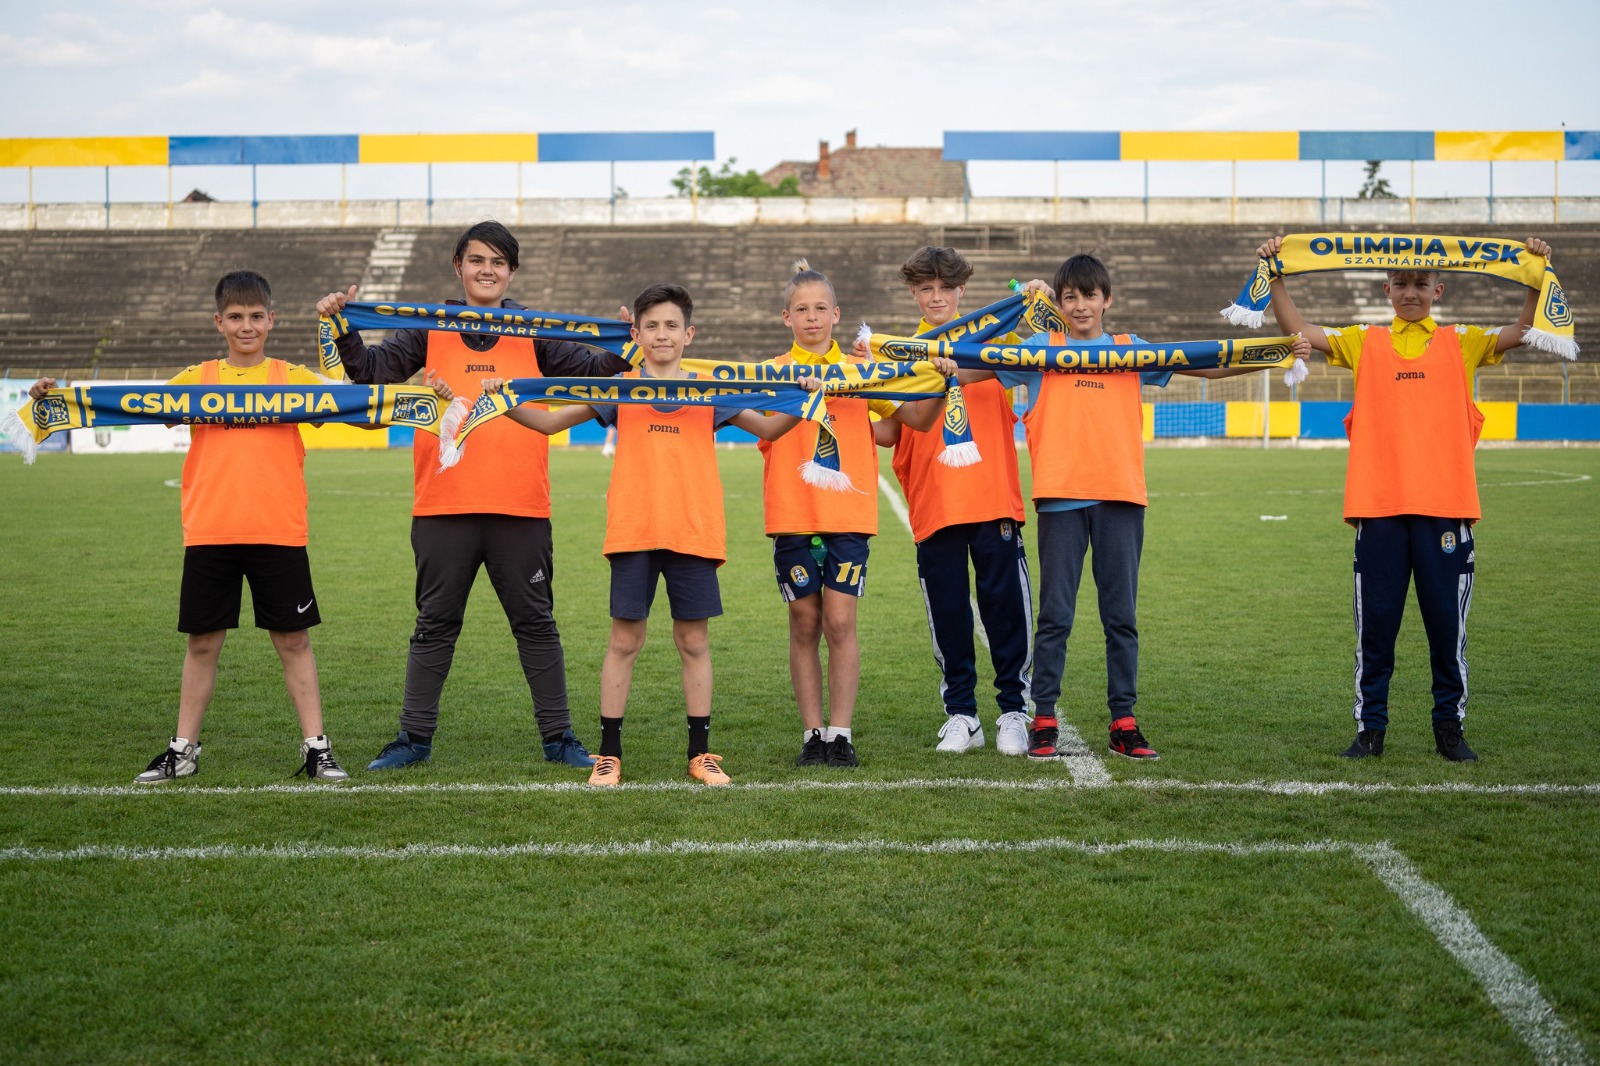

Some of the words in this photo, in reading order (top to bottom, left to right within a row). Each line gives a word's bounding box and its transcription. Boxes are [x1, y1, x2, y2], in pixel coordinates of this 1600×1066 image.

[1309, 237, 1447, 257] OLIMPIA
[1457, 240, 1525, 265] VSK
[1344, 256, 1487, 269] SZATMÁRNÉMETI
[437, 320, 481, 330] SATU
[489, 324, 538, 336] MARE
[980, 346, 1046, 367] CSM
[1055, 349, 1190, 368] OLIMPIA
[712, 364, 847, 381] OLIMPIA
[855, 361, 917, 380] VSK
[120, 392, 190, 414] CSM
[200, 392, 339, 414] OLIMPIA
[182, 416, 225, 424] SATU
[233, 416, 280, 424] MARE
[836, 561, 862, 586] 11
